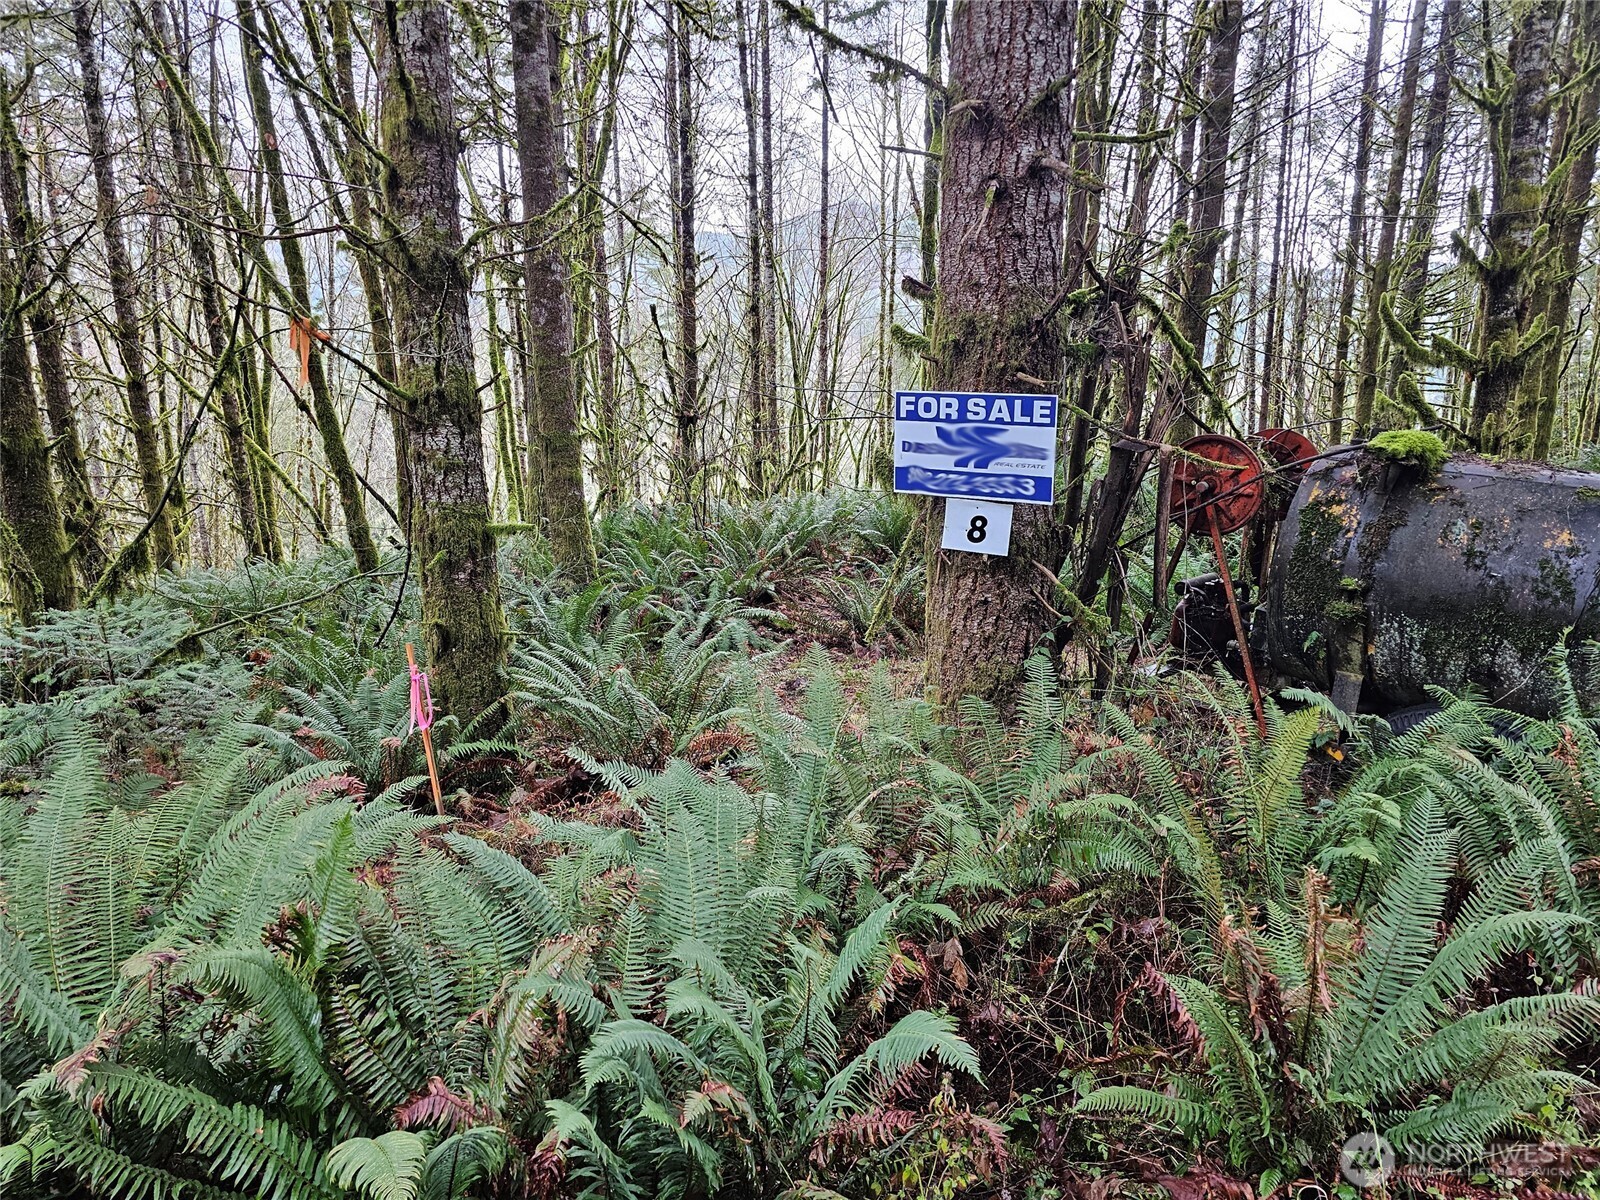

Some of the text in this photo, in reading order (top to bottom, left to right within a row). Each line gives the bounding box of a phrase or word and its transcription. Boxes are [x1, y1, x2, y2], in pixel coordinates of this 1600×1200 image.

[899, 396, 1052, 424] FOR SALE
[1015, 462, 1046, 470] ESTATE
[966, 515, 988, 544] 8
